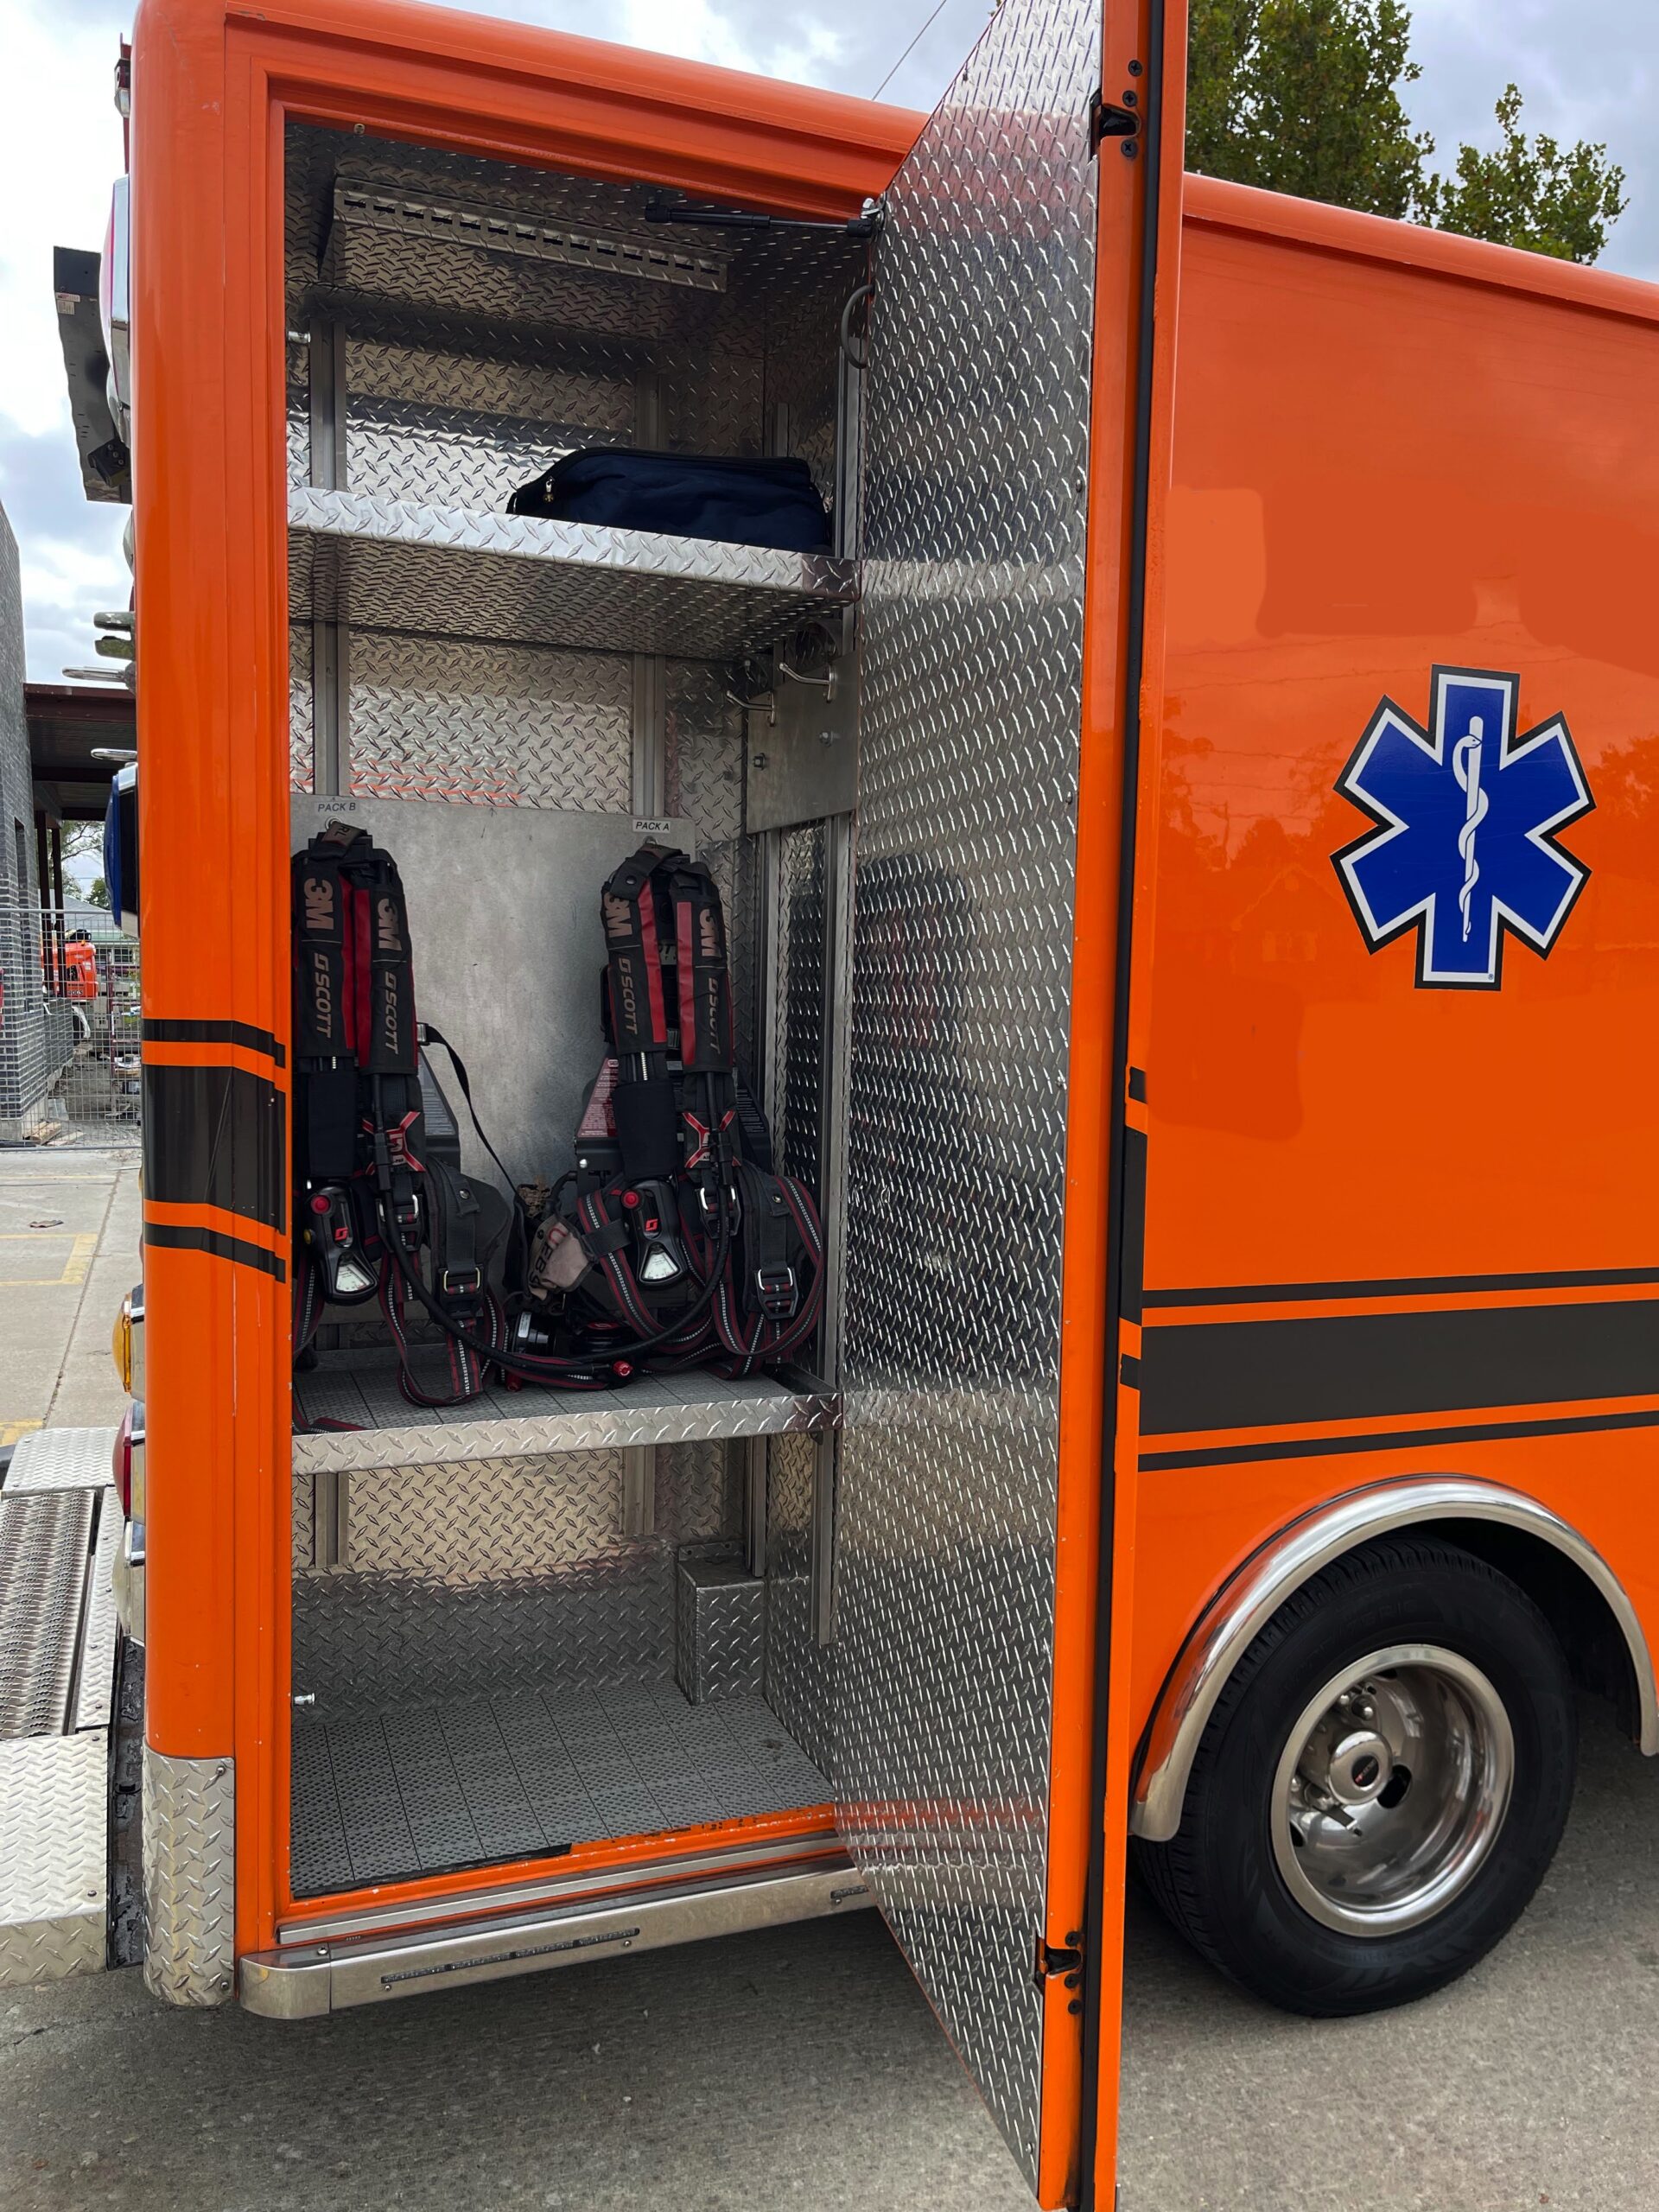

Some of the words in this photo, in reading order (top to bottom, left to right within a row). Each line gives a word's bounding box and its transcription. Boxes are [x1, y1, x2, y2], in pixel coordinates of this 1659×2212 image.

[317, 803, 346, 812] PACK
[348, 802, 356, 811] B
[635, 822, 662, 830] PACK
[663, 823, 670, 831] A
[304, 878, 334, 930] 3M
[378, 899, 403, 951] 3M
[605, 893, 632, 938] 3M
[699, 908, 722, 958] 3M
[315, 972, 332, 1039] SCOTT
[385, 989, 399, 1055] SCOTT
[621, 974, 638, 1035] SCOTT
[709, 994, 721, 1055] SCOTT
